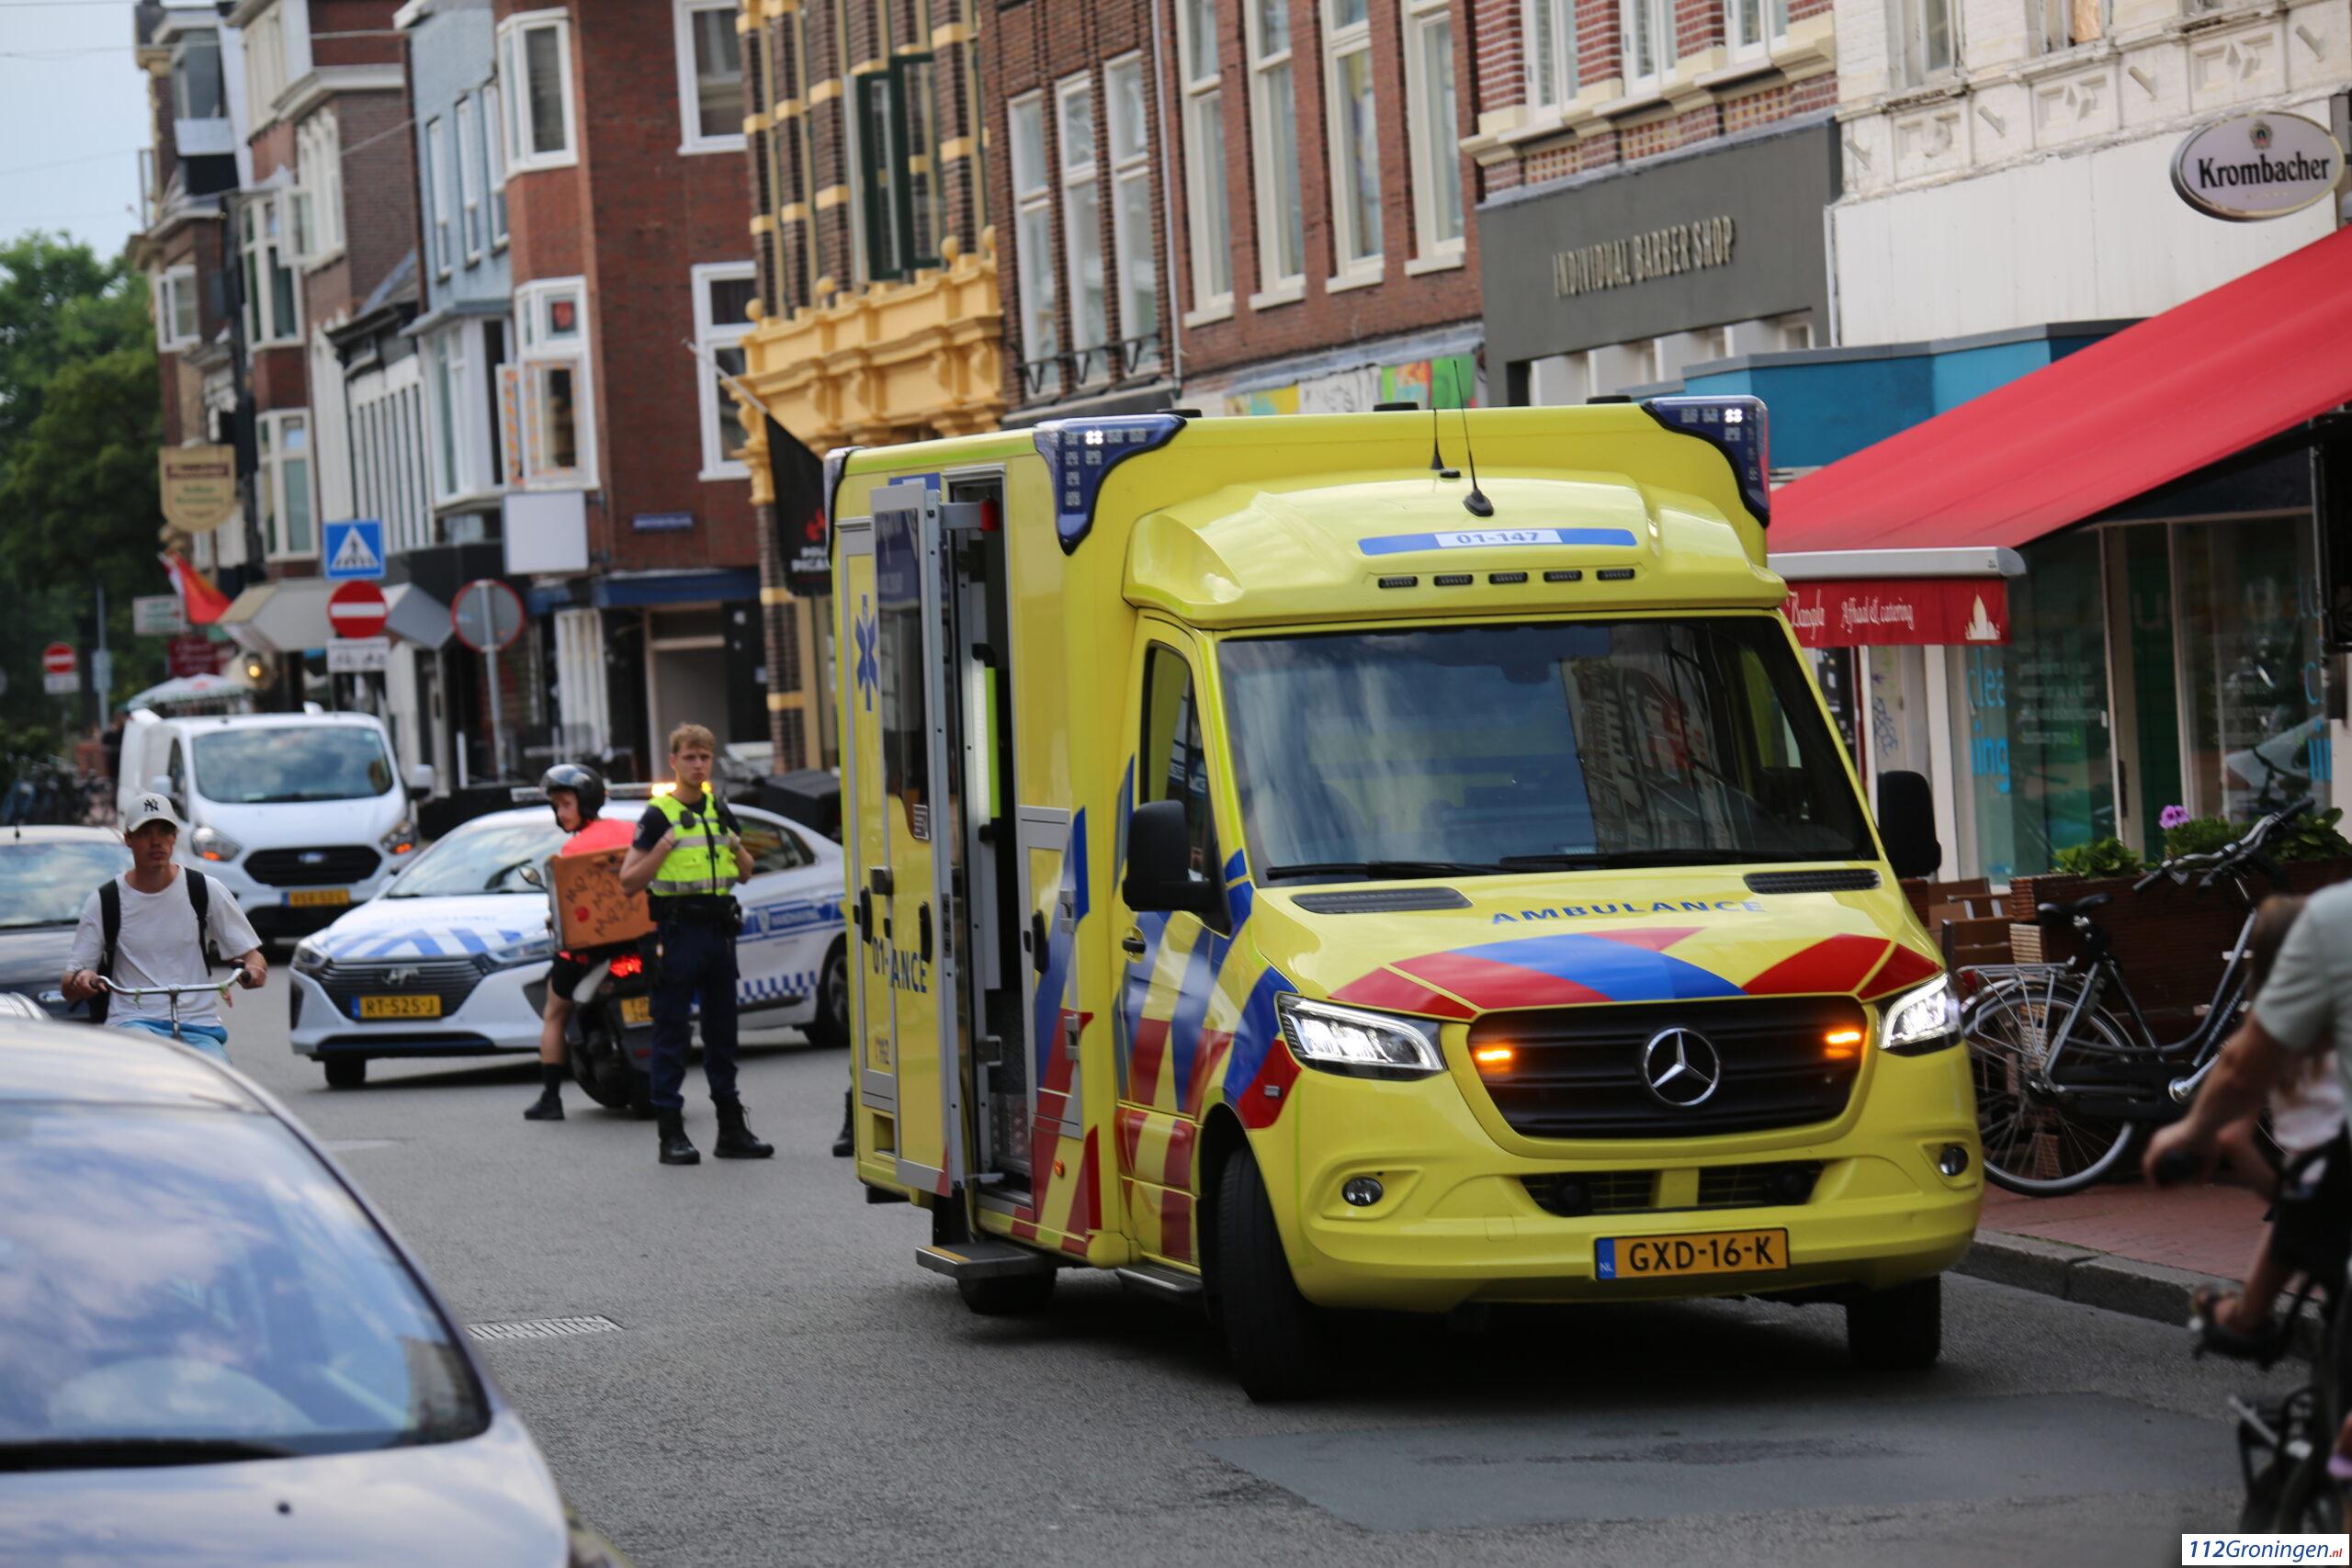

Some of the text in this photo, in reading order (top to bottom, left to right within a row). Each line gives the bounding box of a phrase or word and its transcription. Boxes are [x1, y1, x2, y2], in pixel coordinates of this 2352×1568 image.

[2198, 151, 2331, 188] Krombacher
[1553, 216, 1734, 298] INDIVIDUAL BARBER SHOP
[1455, 532, 1540, 545] 01-147
[1491, 901, 1767, 925] AMBULANCE
[1599, 1235, 1775, 1272] NL GXD-16-K
